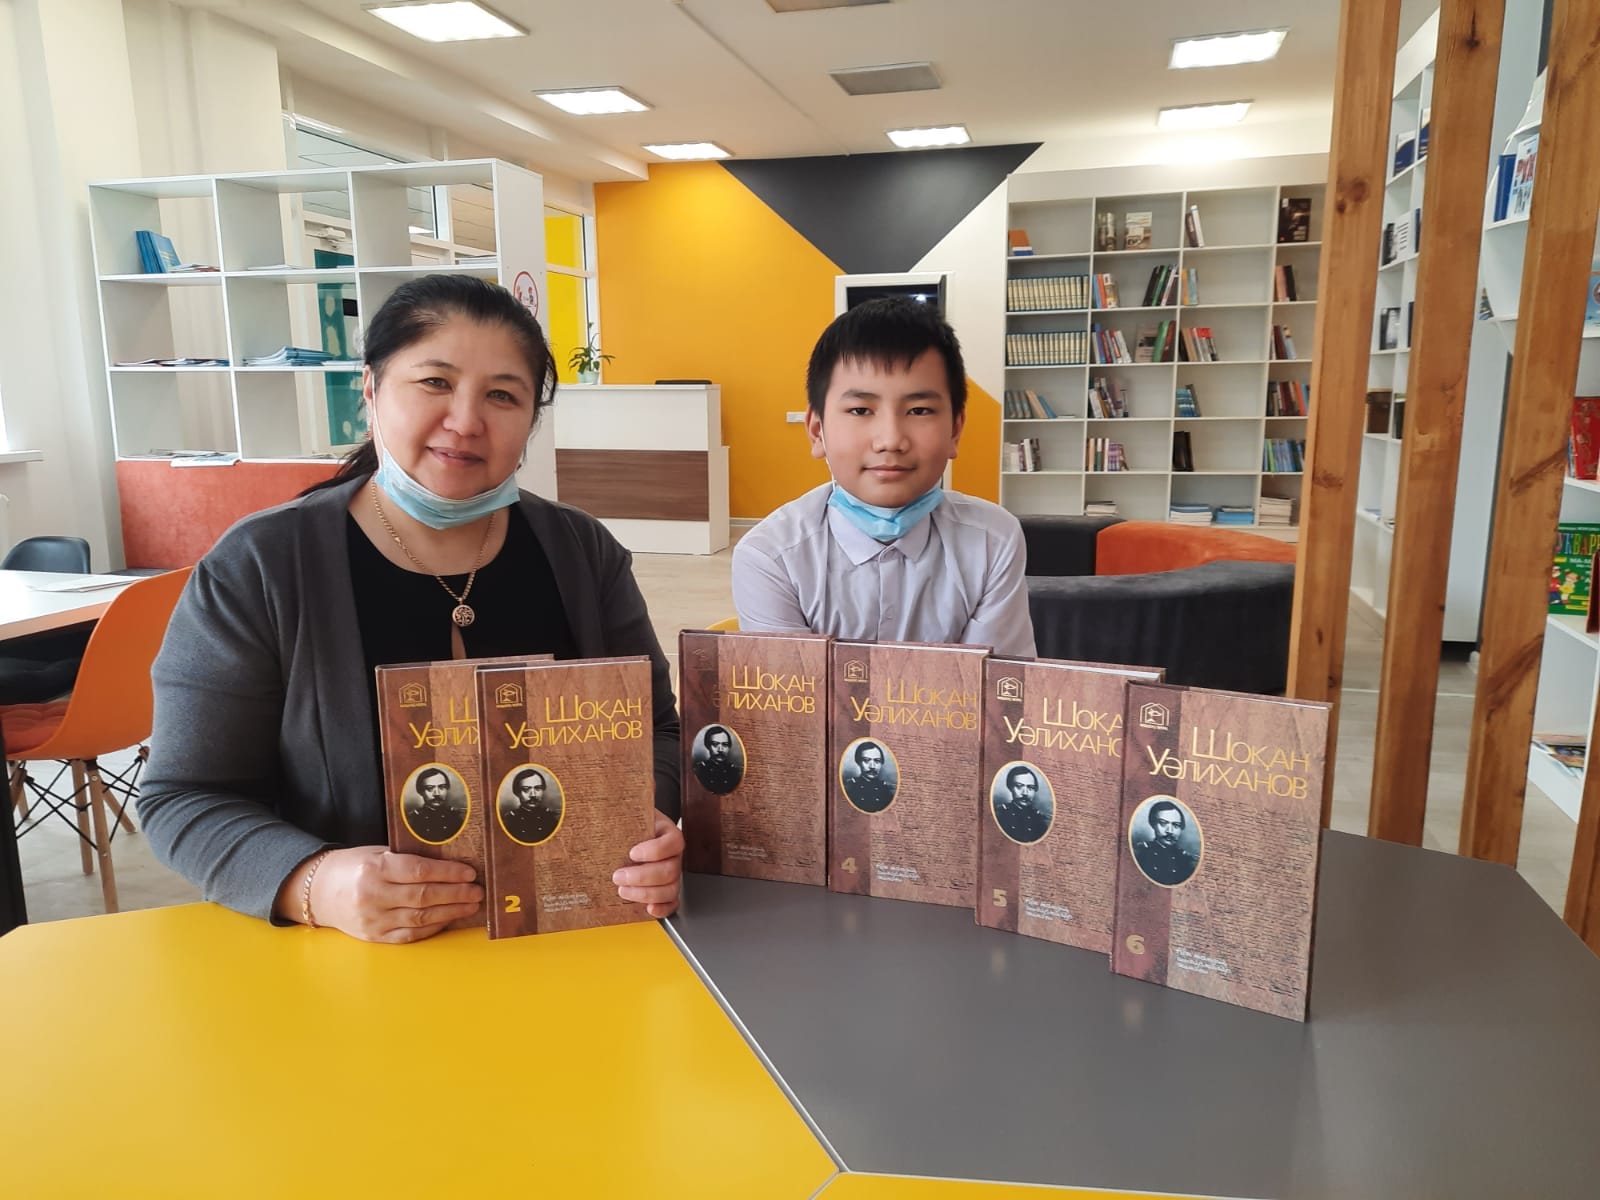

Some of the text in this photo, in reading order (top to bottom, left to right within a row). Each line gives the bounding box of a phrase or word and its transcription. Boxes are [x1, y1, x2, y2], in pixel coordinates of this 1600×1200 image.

[727, 690, 816, 714] ЛИХАНОВ
[1043, 696, 1123, 736] ШОҚА
[841, 857, 856, 874] 4
[505, 895, 521, 913] 2
[993, 888, 1008, 907] 5
[1126, 934, 1145, 955] 6
